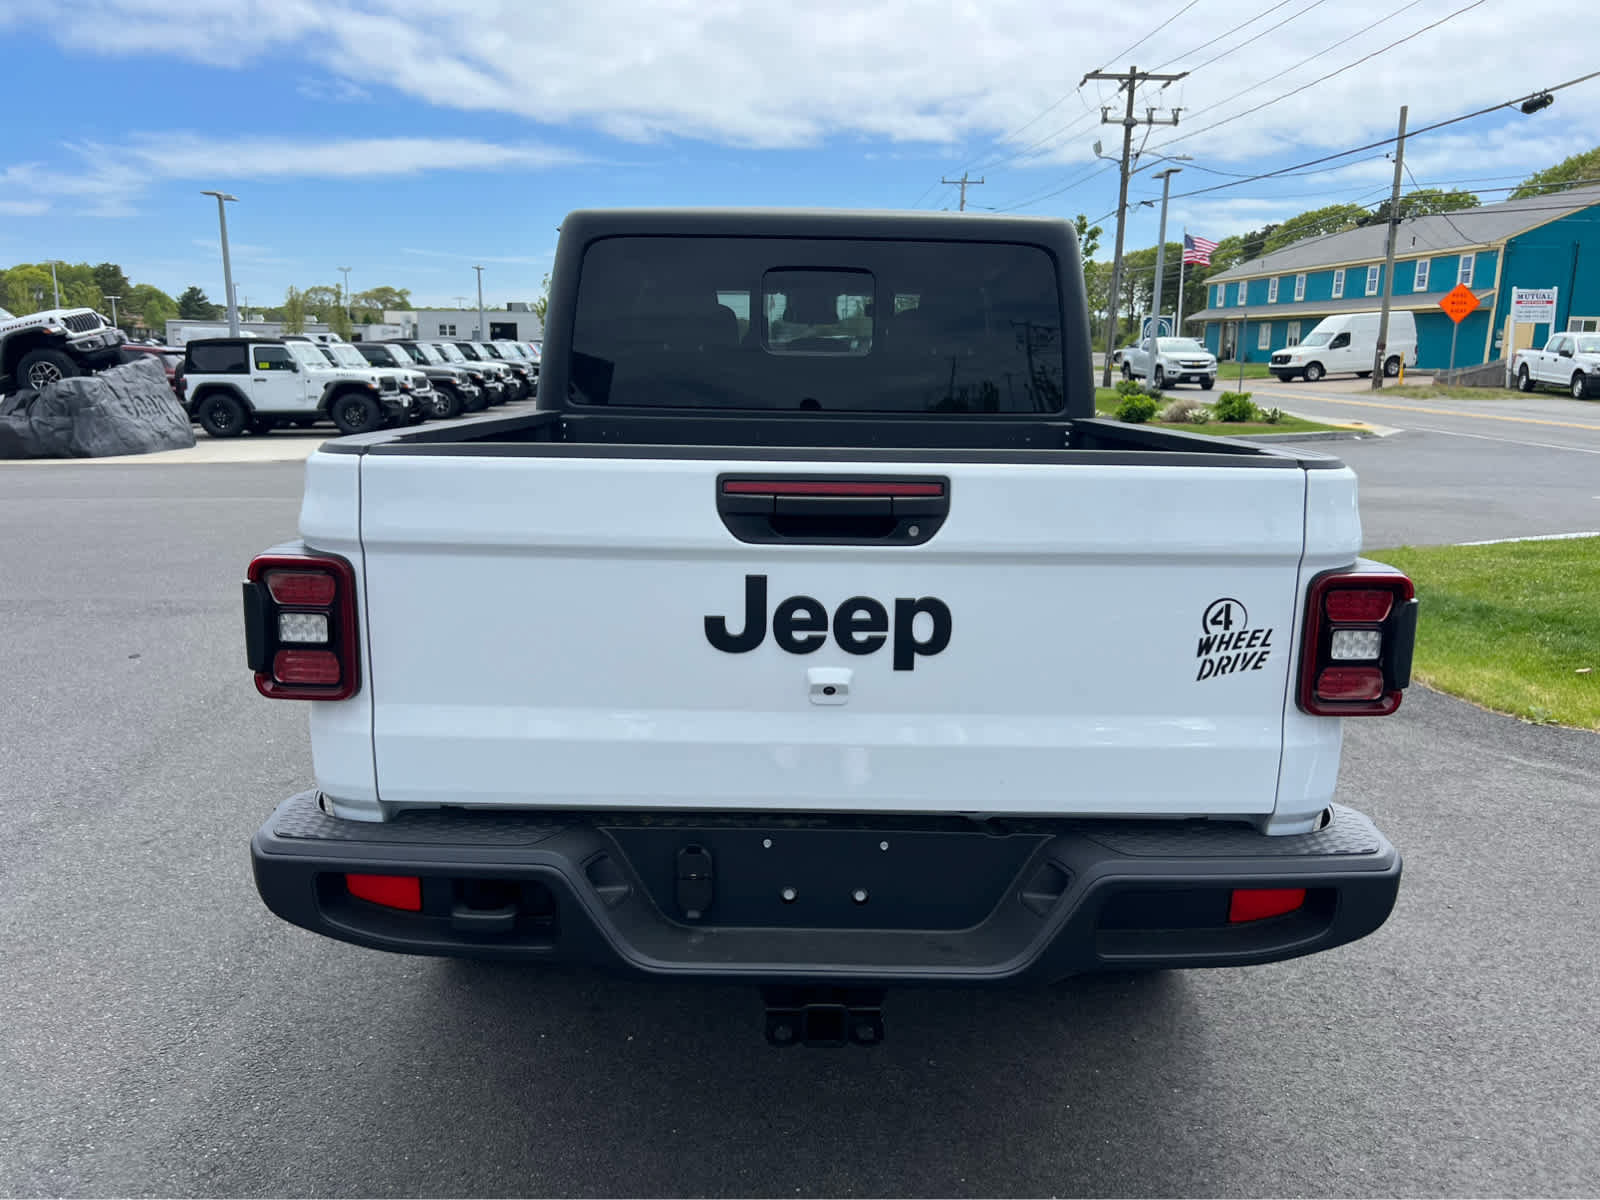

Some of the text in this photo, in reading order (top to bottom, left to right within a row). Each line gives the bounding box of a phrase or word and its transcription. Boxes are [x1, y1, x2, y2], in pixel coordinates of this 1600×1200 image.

[704, 574, 953, 672] Jeep
[1210, 603, 1233, 631] 4
[1197, 628, 1273, 658] WHEEL
[1196, 650, 1271, 681] DRIVE
